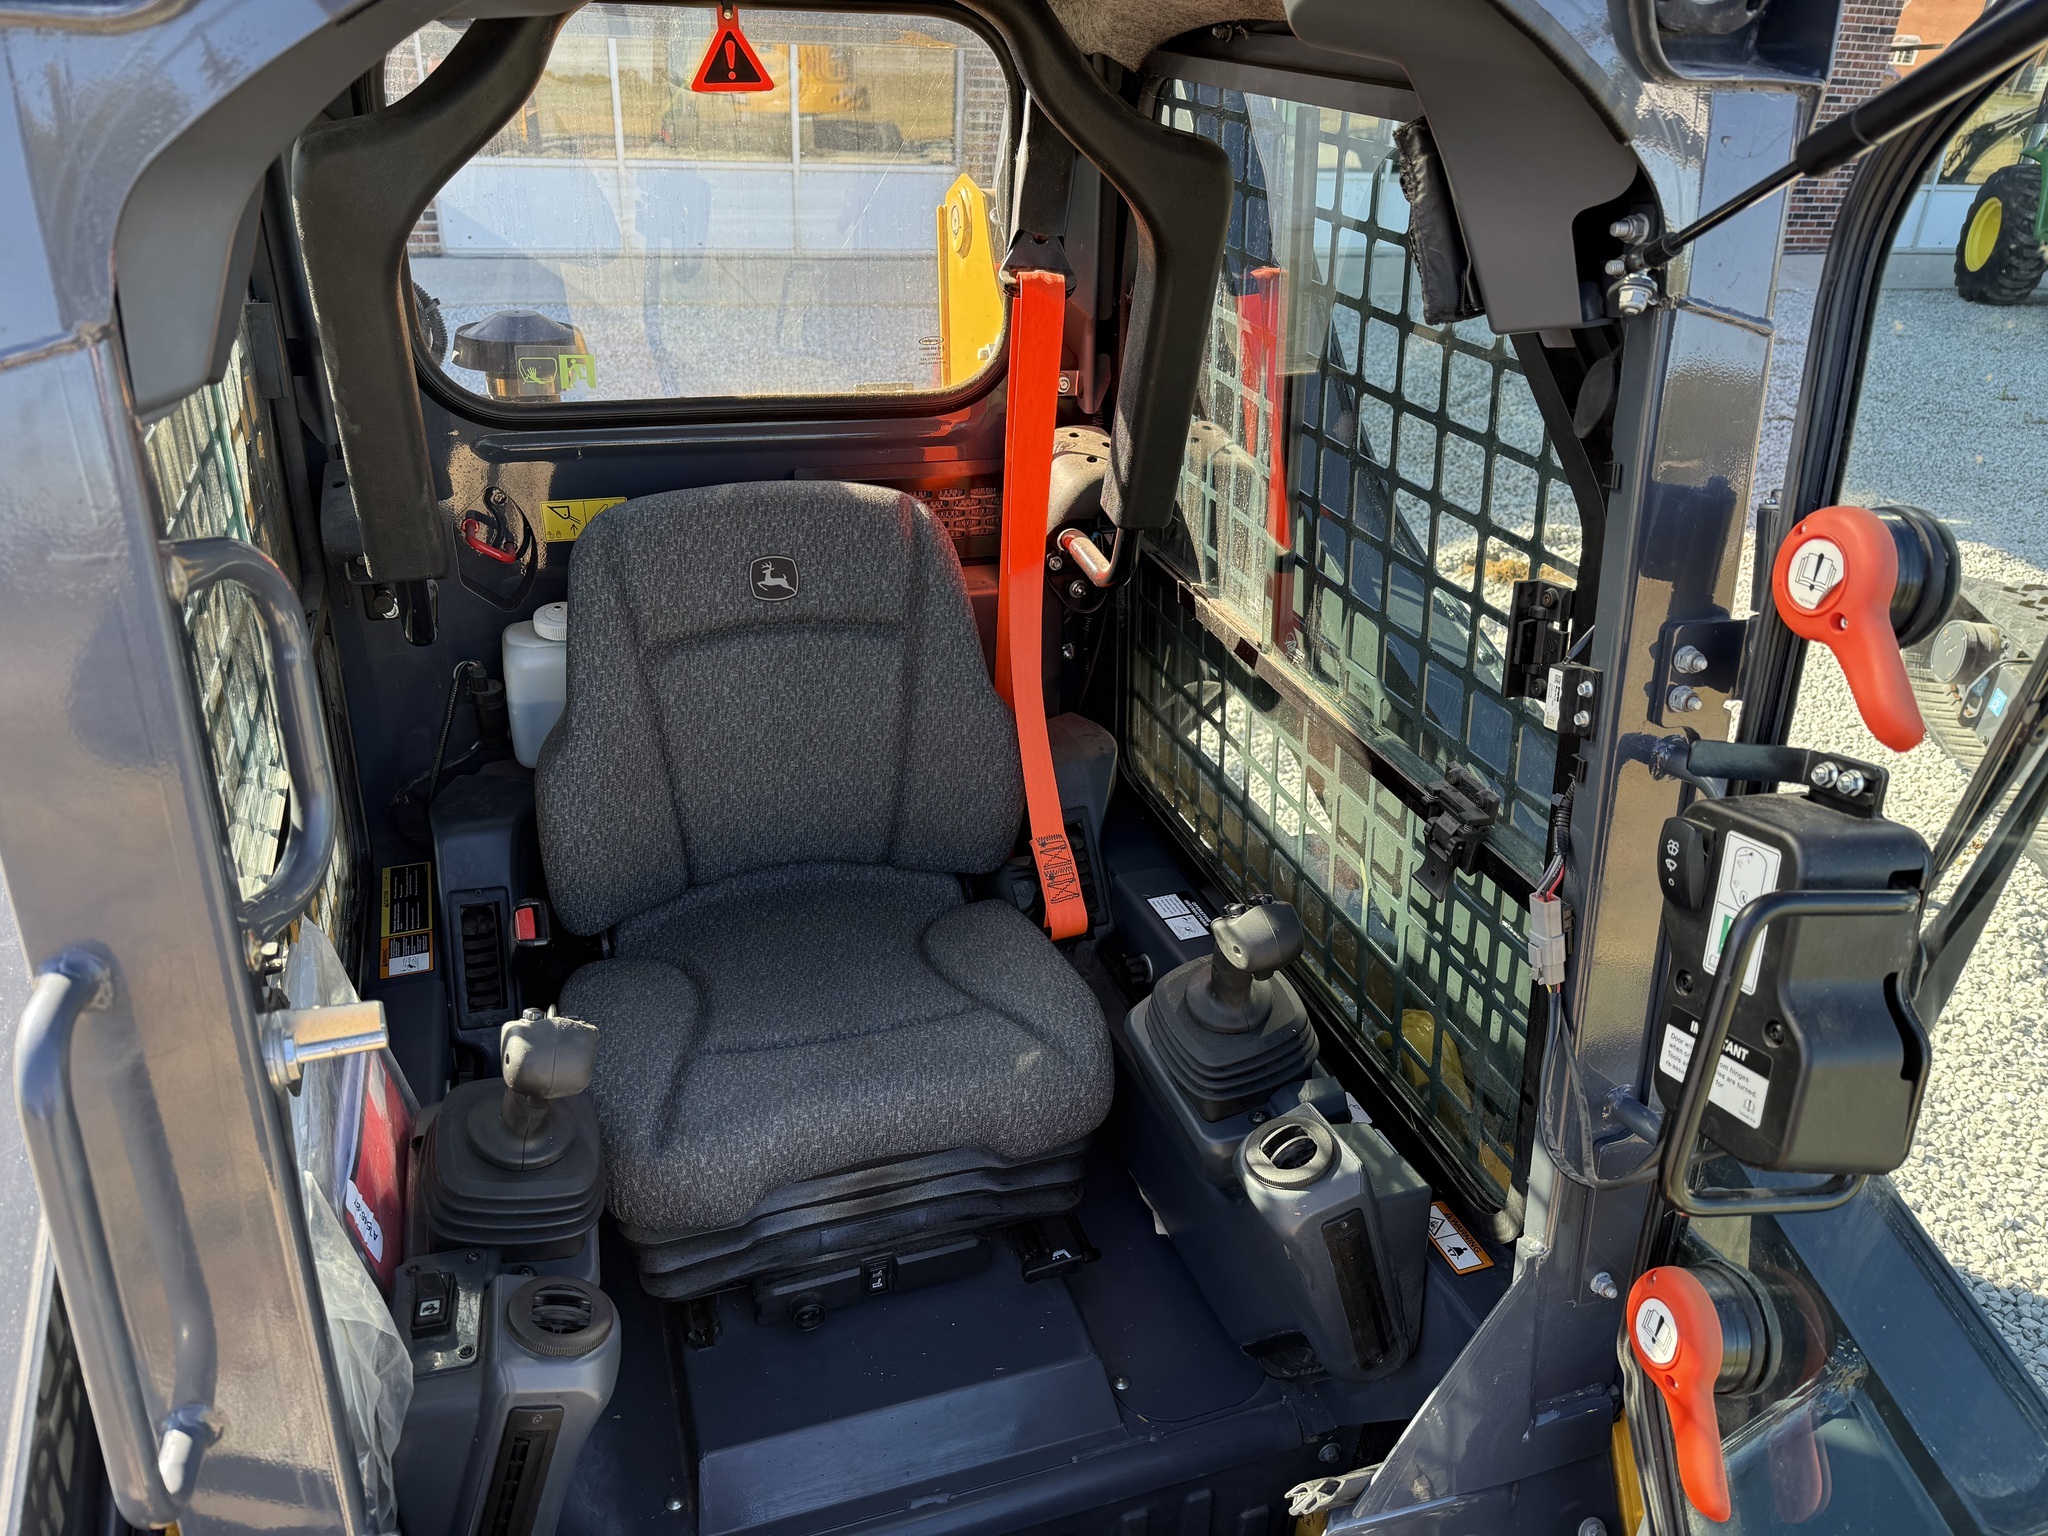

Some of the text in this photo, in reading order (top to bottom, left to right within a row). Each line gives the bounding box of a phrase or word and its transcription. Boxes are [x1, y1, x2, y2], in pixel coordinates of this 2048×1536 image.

[1191, 901, 1212, 923] OPERATING
[1667, 1050, 1681, 1063] Tools
[1715, 1079, 1724, 1088] for
[1669, 1043, 1683, 1055] when
[1726, 1076, 1736, 1086] are
[1671, 1032, 1684, 1045] Door
[1729, 1066, 1749, 1083] hinges
[1450, 1219, 1482, 1253] WARNING
